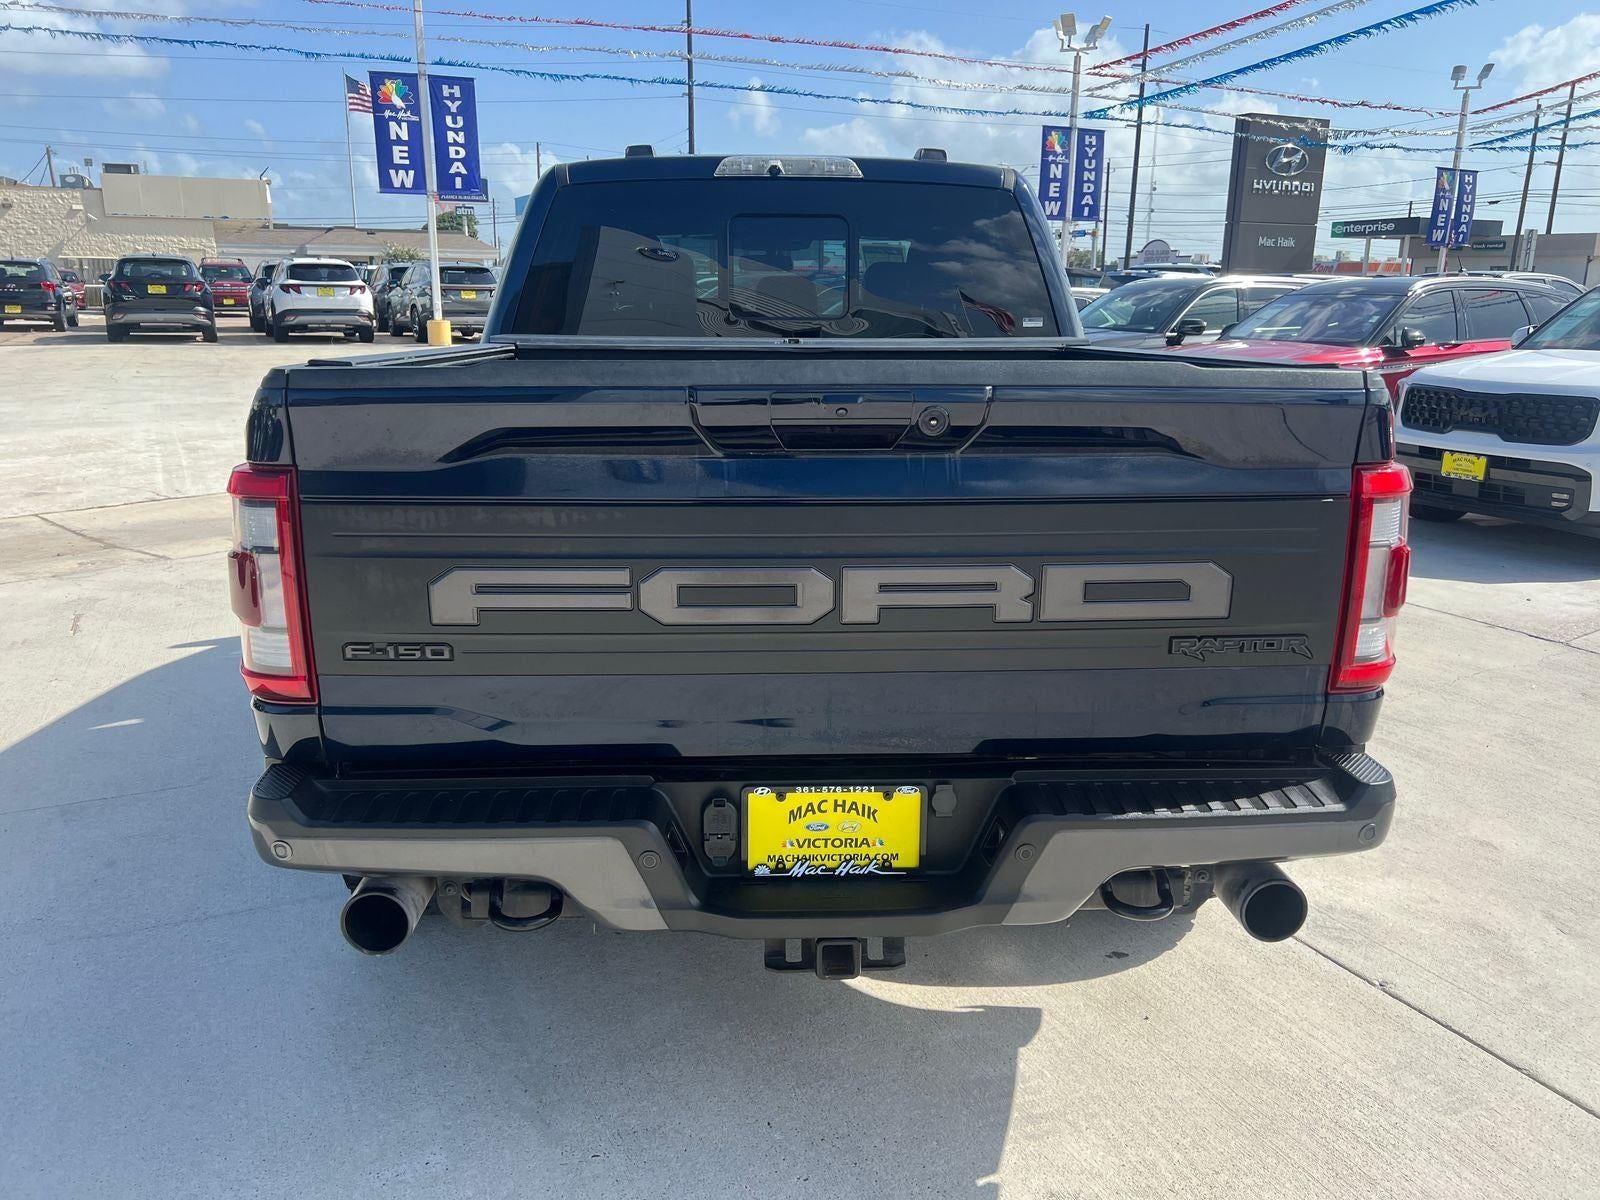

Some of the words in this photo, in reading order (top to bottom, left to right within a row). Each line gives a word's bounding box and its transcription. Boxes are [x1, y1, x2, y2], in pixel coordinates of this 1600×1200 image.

[442, 84, 468, 189] HYUNDAI
[388, 121, 415, 188] NEW
[1081, 135, 1097, 217] HYUNDAI
[1253, 179, 1315, 196] HYUNDAI
[1044, 163, 1063, 216] NEW
[1431, 198, 1449, 242] NEW
[1458, 174, 1473, 242] HYUNDAI
[1333, 221, 1395, 234] enterprise
[1258, 236, 1276, 247] Mac
[1277, 236, 1296, 247] Haik
[427, 561, 1234, 627] FORD
[342, 642, 454, 661] F-150
[1169, 635, 1313, 661] RAPTOR
[787, 799, 828, 824] MAC
[833, 799, 879, 824] HAIK
[795, 837, 871, 849] VICTORIA
[788, 861, 833, 877] Mac
[834, 860, 882, 877] Haik
